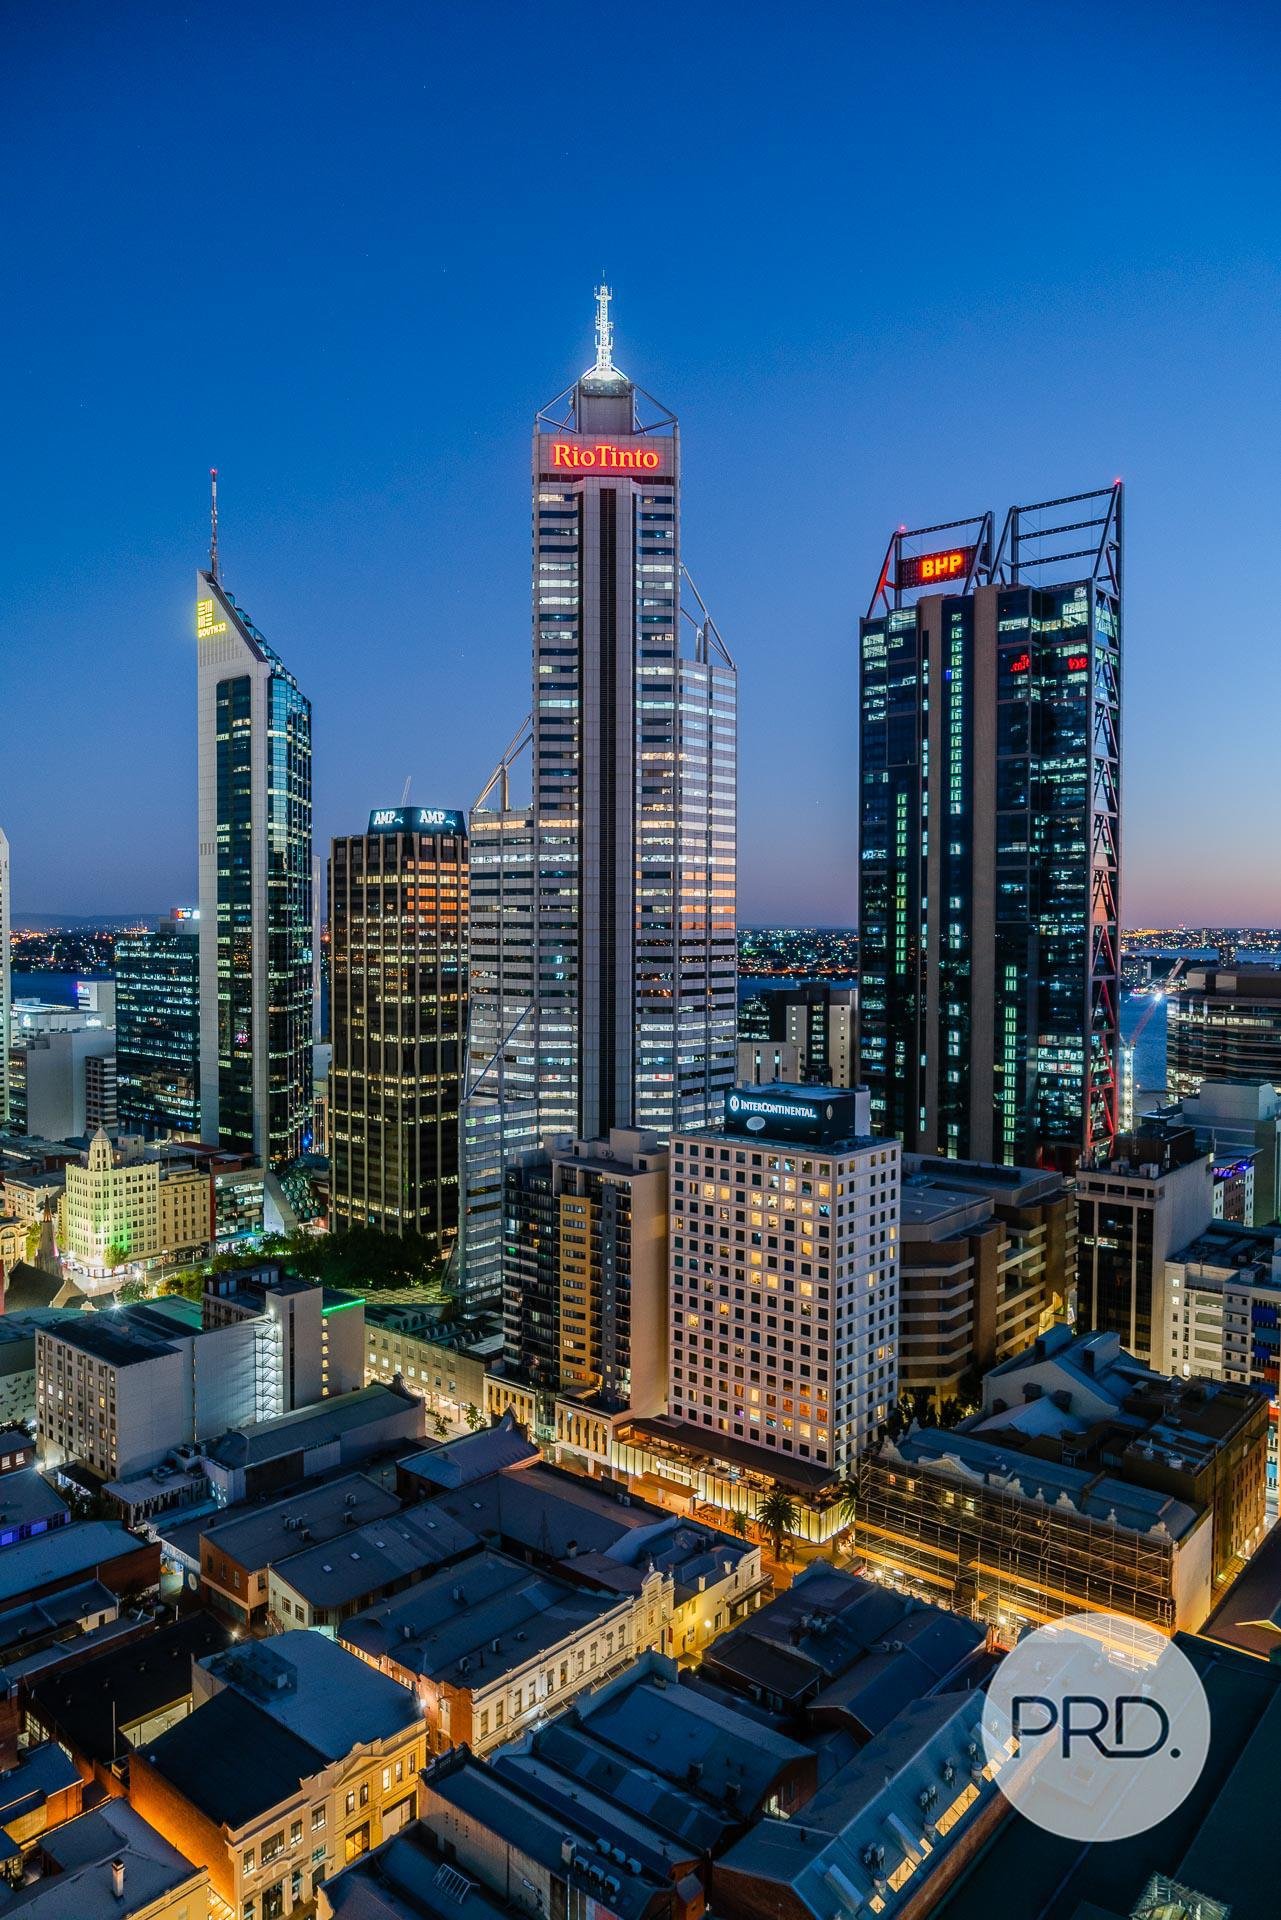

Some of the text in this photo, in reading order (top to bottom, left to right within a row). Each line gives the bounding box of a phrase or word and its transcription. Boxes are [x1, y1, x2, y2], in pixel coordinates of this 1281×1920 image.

[921, 554, 963, 578] BHP
[373, 810, 396, 825] AMP
[419, 809, 446, 825] AMP
